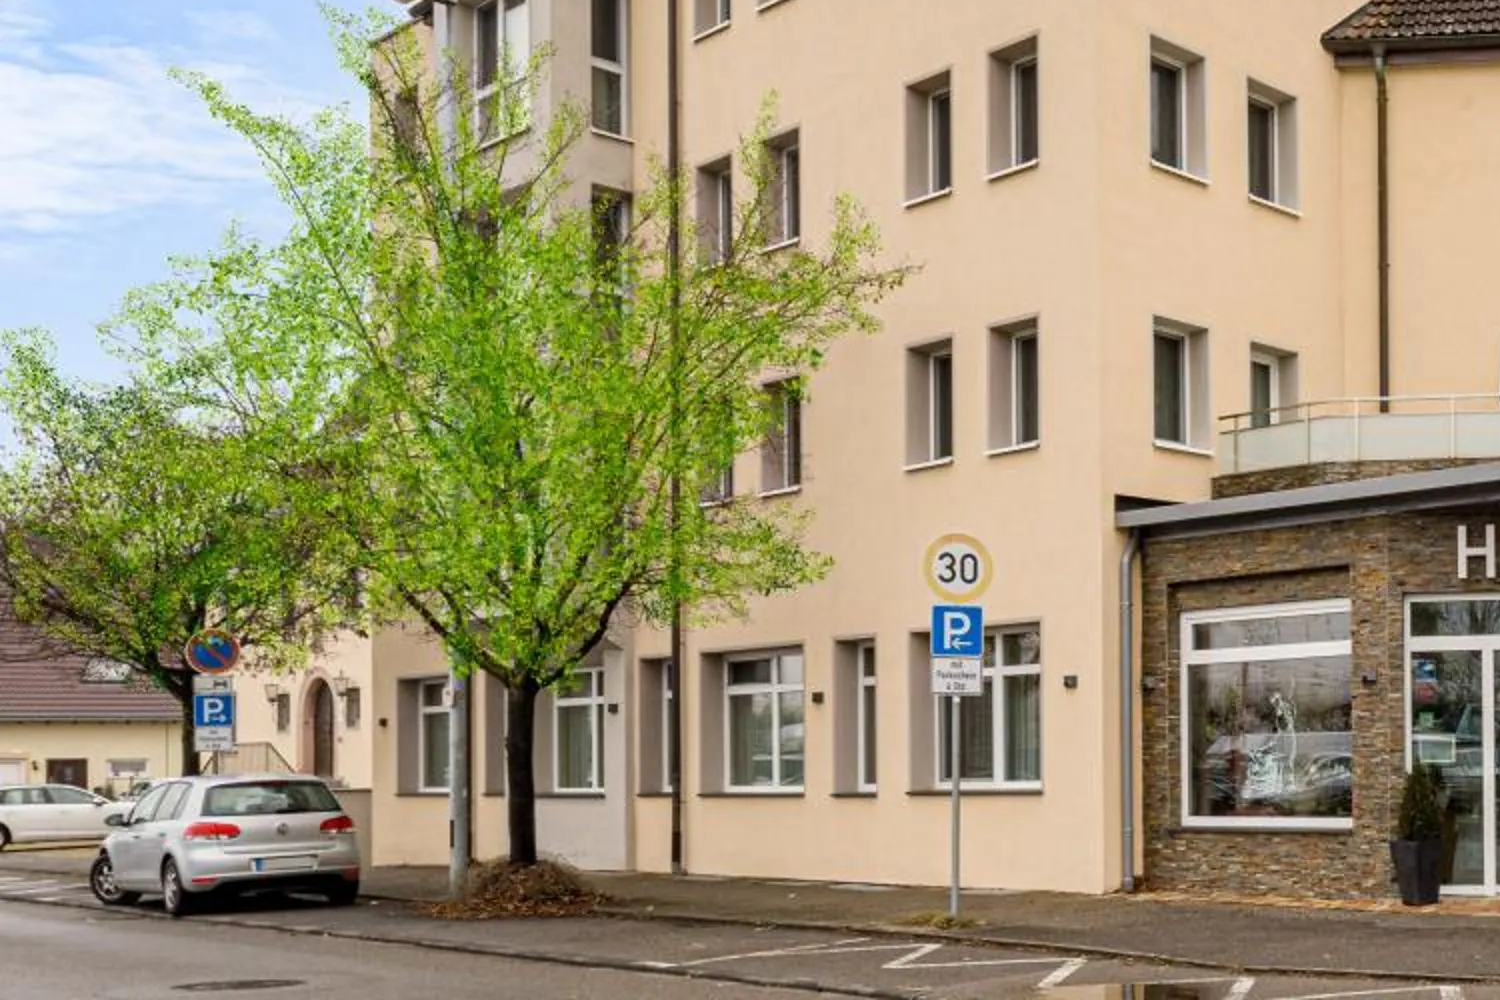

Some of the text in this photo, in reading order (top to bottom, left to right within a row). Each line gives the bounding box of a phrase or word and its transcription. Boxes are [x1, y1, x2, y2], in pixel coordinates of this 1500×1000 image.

[938, 552, 978, 584] 30
[943, 611, 971, 649] P
[203, 698, 224, 723] P
